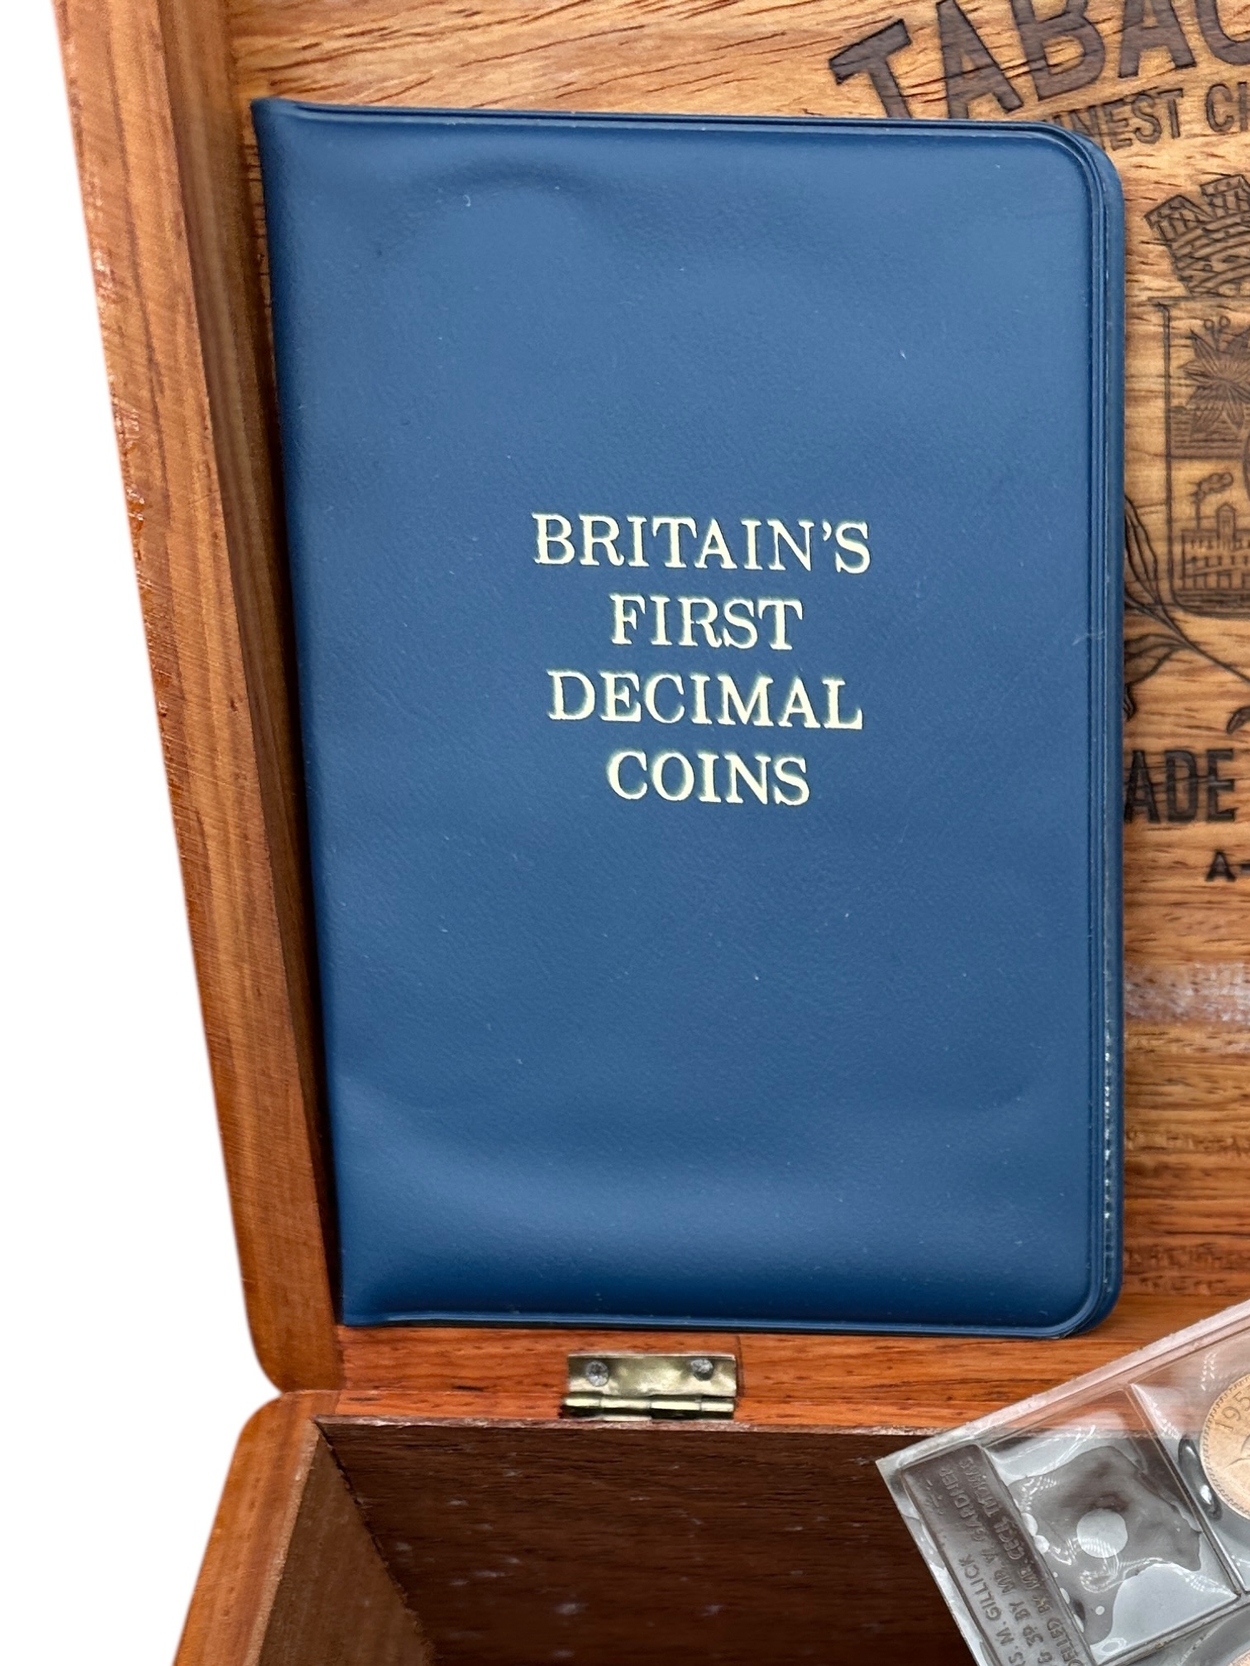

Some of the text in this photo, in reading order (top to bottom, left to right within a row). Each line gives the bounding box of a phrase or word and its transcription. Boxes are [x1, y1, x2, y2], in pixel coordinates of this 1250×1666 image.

[1058, 87, 1184, 151] NEST
[531, 512, 871, 574] BRITAIN'S
[609, 593, 803, 650] FIRST
[546, 669, 863, 731] DECIMAL
[607, 749, 810, 806] COINS
[957, 1552, 1003, 1622] GILLICK
[1008, 1597, 1029, 1621] BY
[1032, 1591, 1052, 1613] BY
